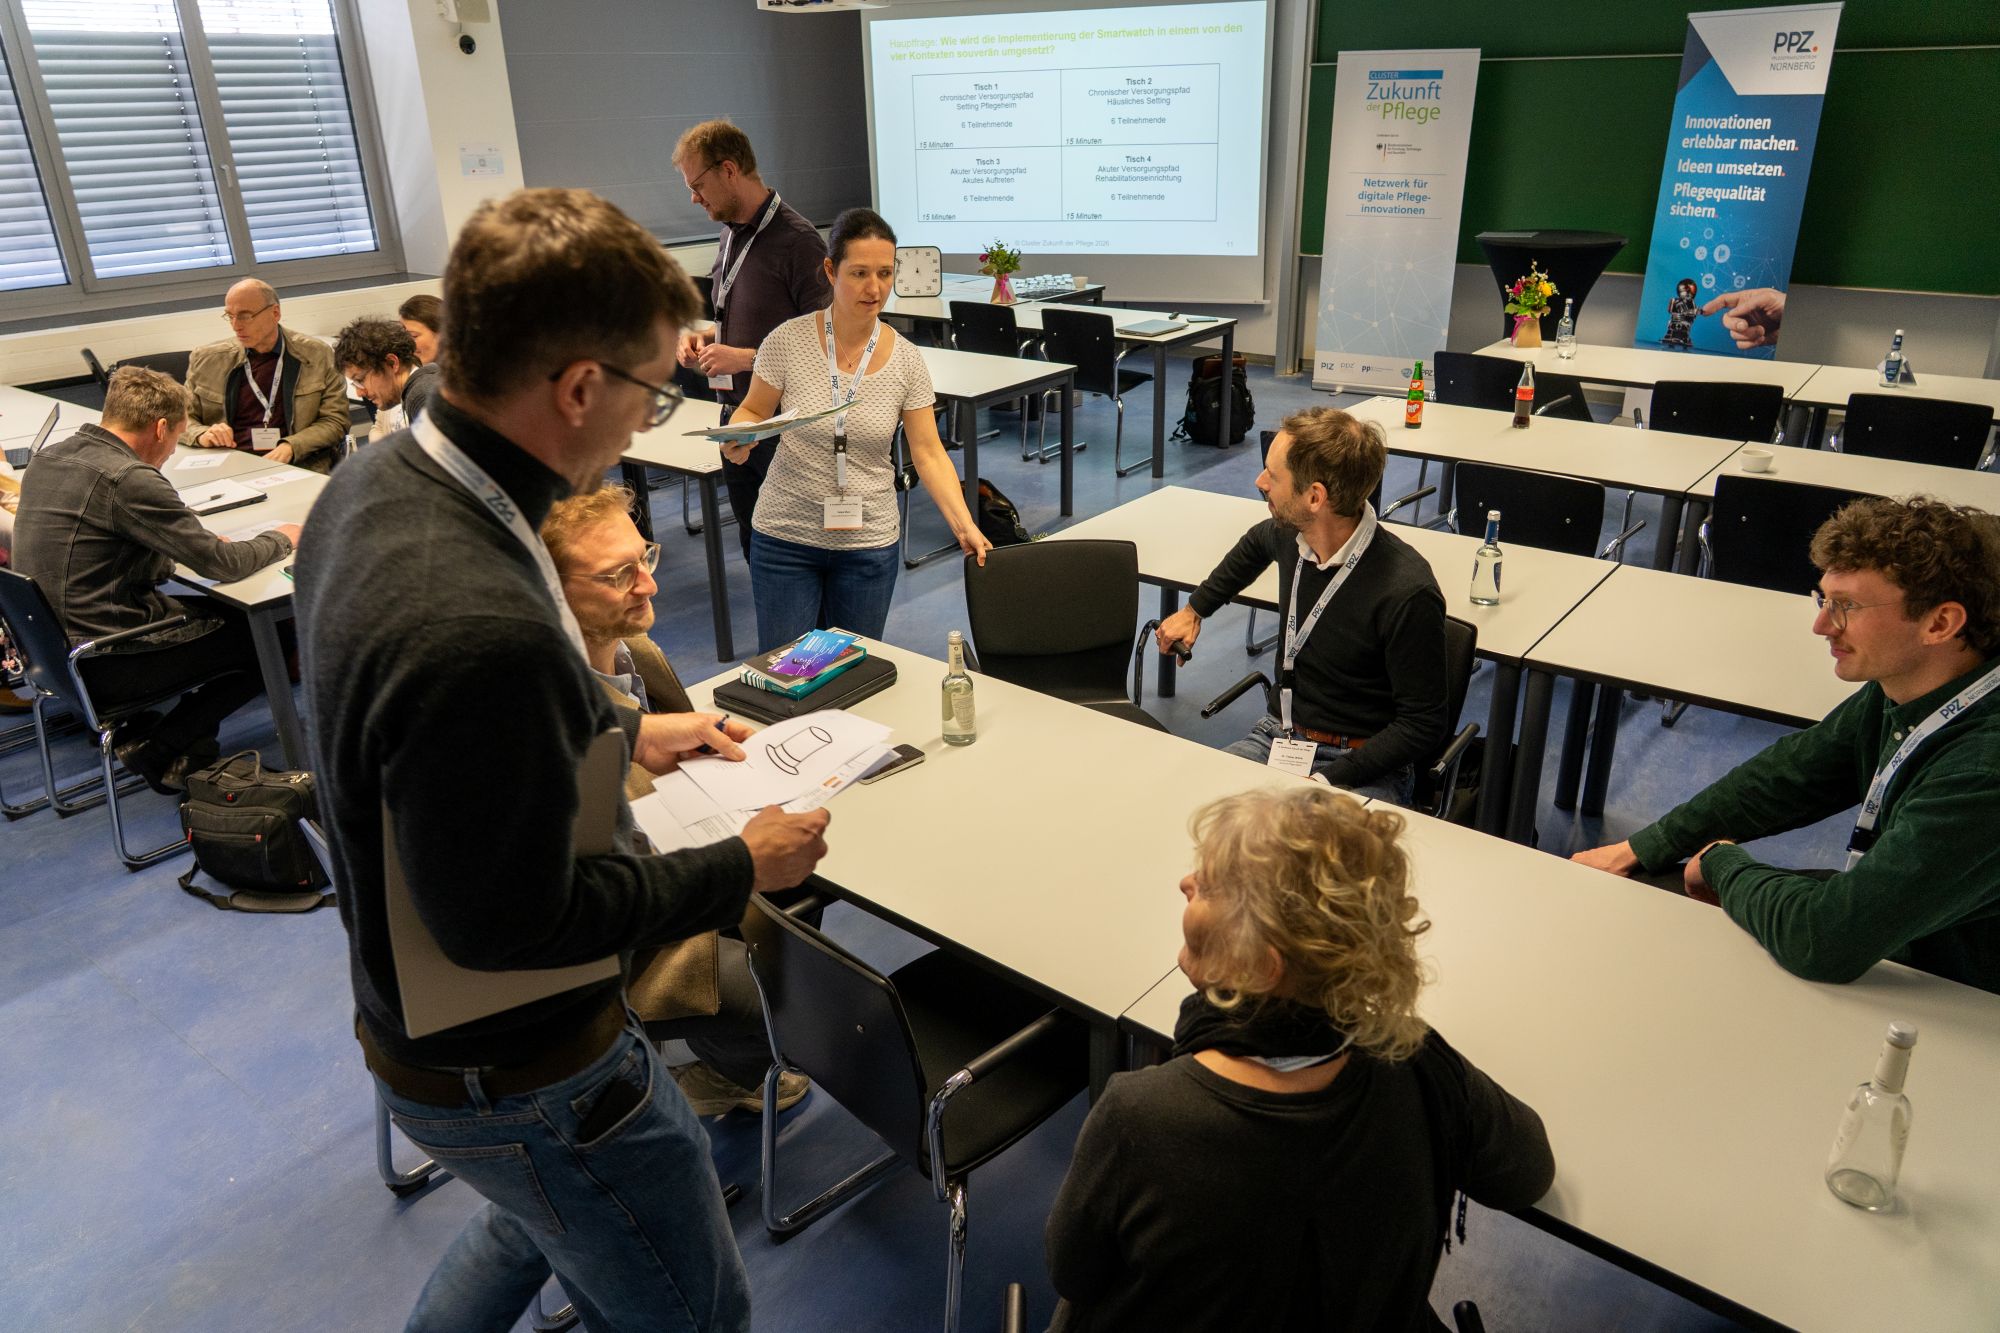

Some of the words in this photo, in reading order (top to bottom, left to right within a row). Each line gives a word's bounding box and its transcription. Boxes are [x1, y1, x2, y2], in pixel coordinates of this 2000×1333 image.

[940, 36, 957, 46] Wie
[960, 36, 980, 45] wird
[982, 35, 996, 44] die
[998, 31, 1076, 44] Implementierung
[1079, 30, 1094, 40] der
[1097, 27, 1154, 40] Smartwatch
[1157, 26, 1166, 36] in
[1168, 25, 1199, 36] einem
[1202, 24, 1221, 34] von
[1224, 24, 1243, 33] den
[1774, 30, 1818, 54] PPZ.
[890, 52, 908, 62] vier
[909, 50, 954, 60] Kontexten
[957, 48, 999, 58] souverän
[1001, 44, 1055, 58] umgesetzt?
[1770, 62, 1816, 71] NÜRNBERG
[1370, 72, 1400, 80] CLUSTER
[1088, 88, 1130, 96] Chronischer
[1131, 86, 1191, 96] Versorgungspfad
[1366, 81, 1442, 100] Zukunft
[978, 91, 1034, 101] Versorgungspfad
[1106, 98, 1144, 106] Häusliches
[1146, 96, 1172, 106] Setting
[956, 102, 979, 112] Setting
[980, 102, 1017, 111] Pflegeheim
[1366, 103, 1381, 112] der
[1382, 101, 1441, 124] Pflege
[968, 120, 1013, 128] Teilnehmende
[1118, 116, 1166, 125] Teilnehmende
[1685, 114, 1772, 130] Innovationen
[920, 141, 928, 149] 15
[928, 140, 954, 148] Minuten
[1076, 137, 1102, 145] Minuten
[1682, 134, 1738, 150] erlebbar
[1740, 135, 1799, 150] machen.
[976, 158, 995, 166] Tisch
[1126, 155, 1146, 163] Tisch
[972, 167, 1027, 177] Versorgungspfad
[1121, 164, 1180, 174] Versorgungspfad
[1678, 158, 1713, 174] Ideen
[1716, 162, 1786, 176] umsetzen.
[986, 176, 1015, 184] Auftreten
[1095, 174, 1182, 183] Rehabilitationseinrichtung
[1363, 178, 1410, 188] Netzwerk
[1413, 178, 1428, 189] für
[1117, 192, 1166, 200] Teilnehmende
[1673, 182, 1766, 202] Pflegequalität
[970, 194, 1014, 202] Teilnehmende
[1358, 191, 1394, 202] digitale
[1396, 192, 1432, 204] Pflege-
[1360, 204, 1426, 214] innovationen
[1670, 202, 1718, 218] sichern.
[1076, 212, 1102, 220] Minuten
